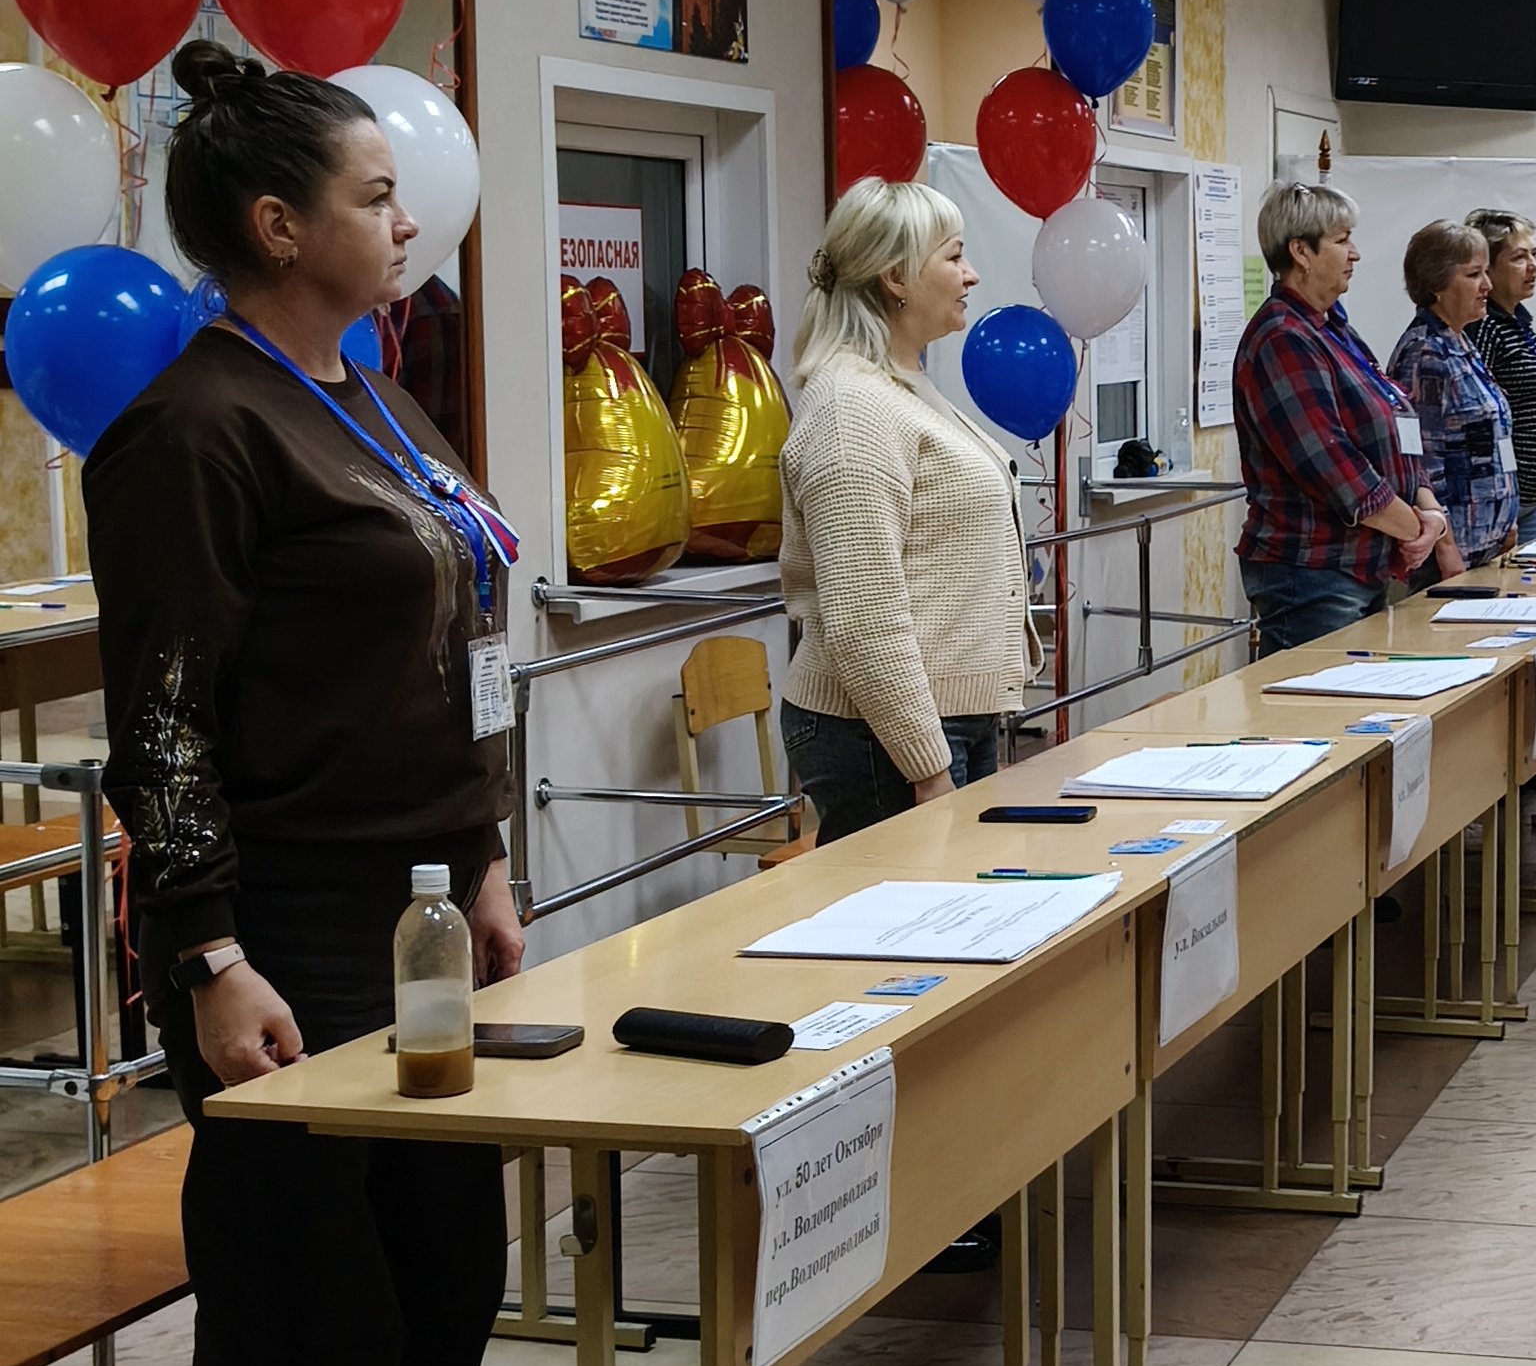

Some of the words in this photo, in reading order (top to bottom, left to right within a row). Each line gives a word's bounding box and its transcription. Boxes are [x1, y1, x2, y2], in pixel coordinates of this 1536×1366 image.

[560, 237, 640, 269] ЕЗОПАСНАЯ
[775, 1178, 792, 1208] ул.
[795, 1160, 810, 1189] 50
[813, 1153, 832, 1177] лет
[835, 1121, 884, 1165] Октября
[772, 1233, 791, 1260] ул.
[793, 1171, 878, 1240] Водопроводная
